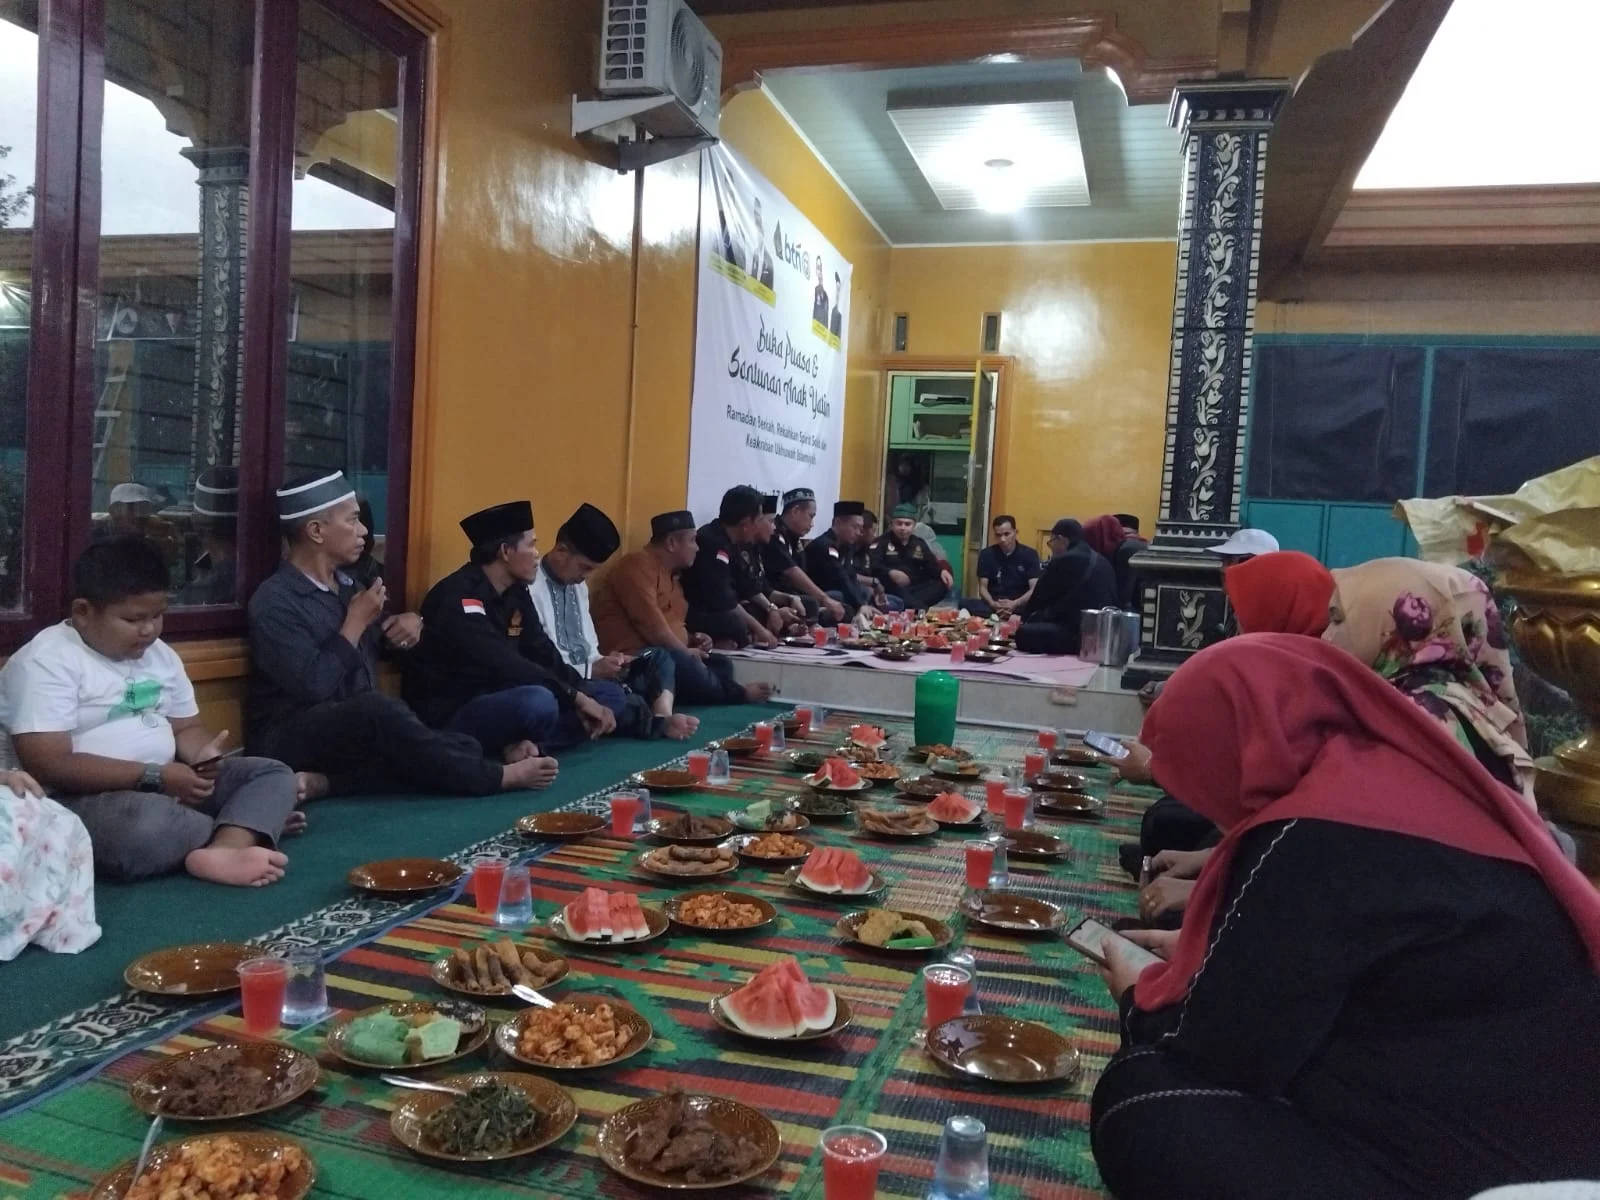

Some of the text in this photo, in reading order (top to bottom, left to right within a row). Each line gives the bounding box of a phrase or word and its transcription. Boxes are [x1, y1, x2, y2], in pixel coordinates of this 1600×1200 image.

[757, 314, 783, 359] Buka
[784, 330, 810, 373] Puasa
[812, 353, 819, 378] &
[728, 345, 830, 420] Santunan Anak Yatim
[726, 404, 756, 428] Ramadan
